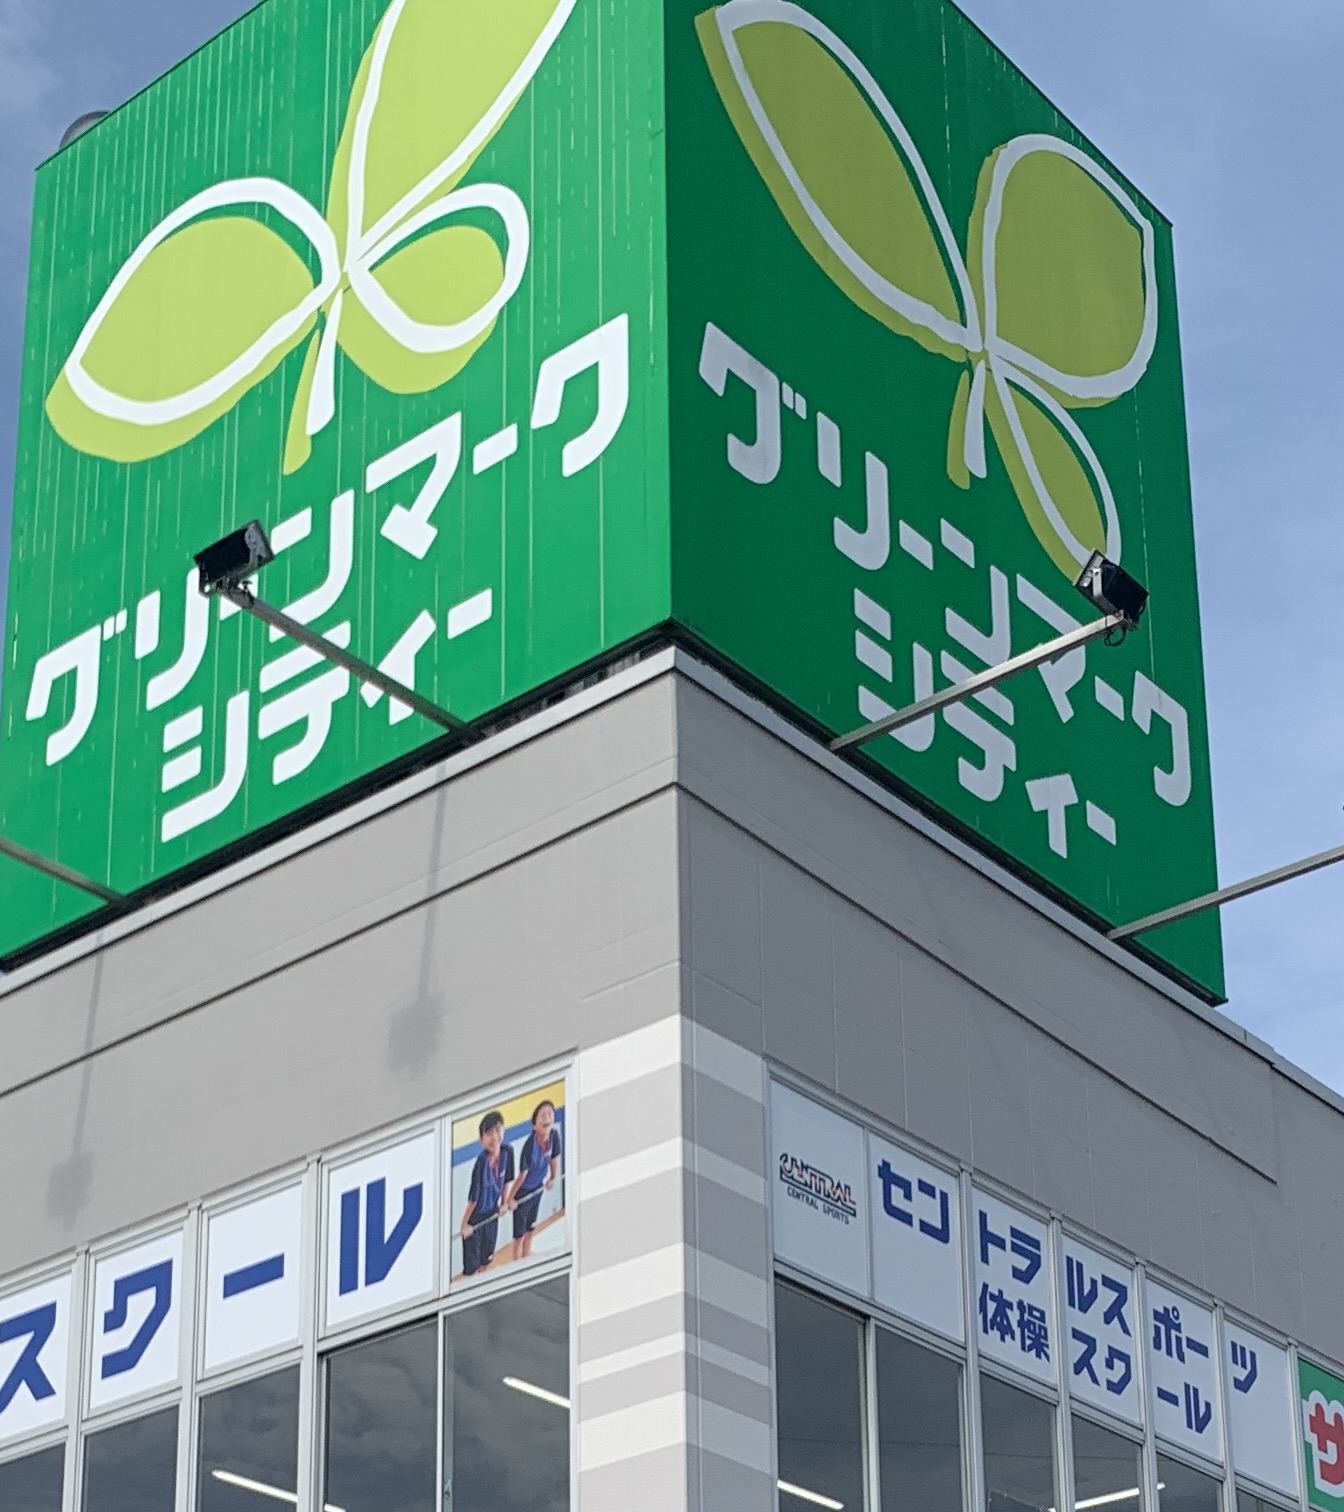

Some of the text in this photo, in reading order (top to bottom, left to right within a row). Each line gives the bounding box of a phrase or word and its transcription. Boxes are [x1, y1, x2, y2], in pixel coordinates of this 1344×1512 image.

[698, 320, 1192, 807] グリーンマーク
[161, 588, 493, 842] シティー
[853, 587, 1118, 860] シティー
[877, 1159, 1258, 1393] セントラルスポーツ
[978, 1282, 1212, 1435] 体操スクール
